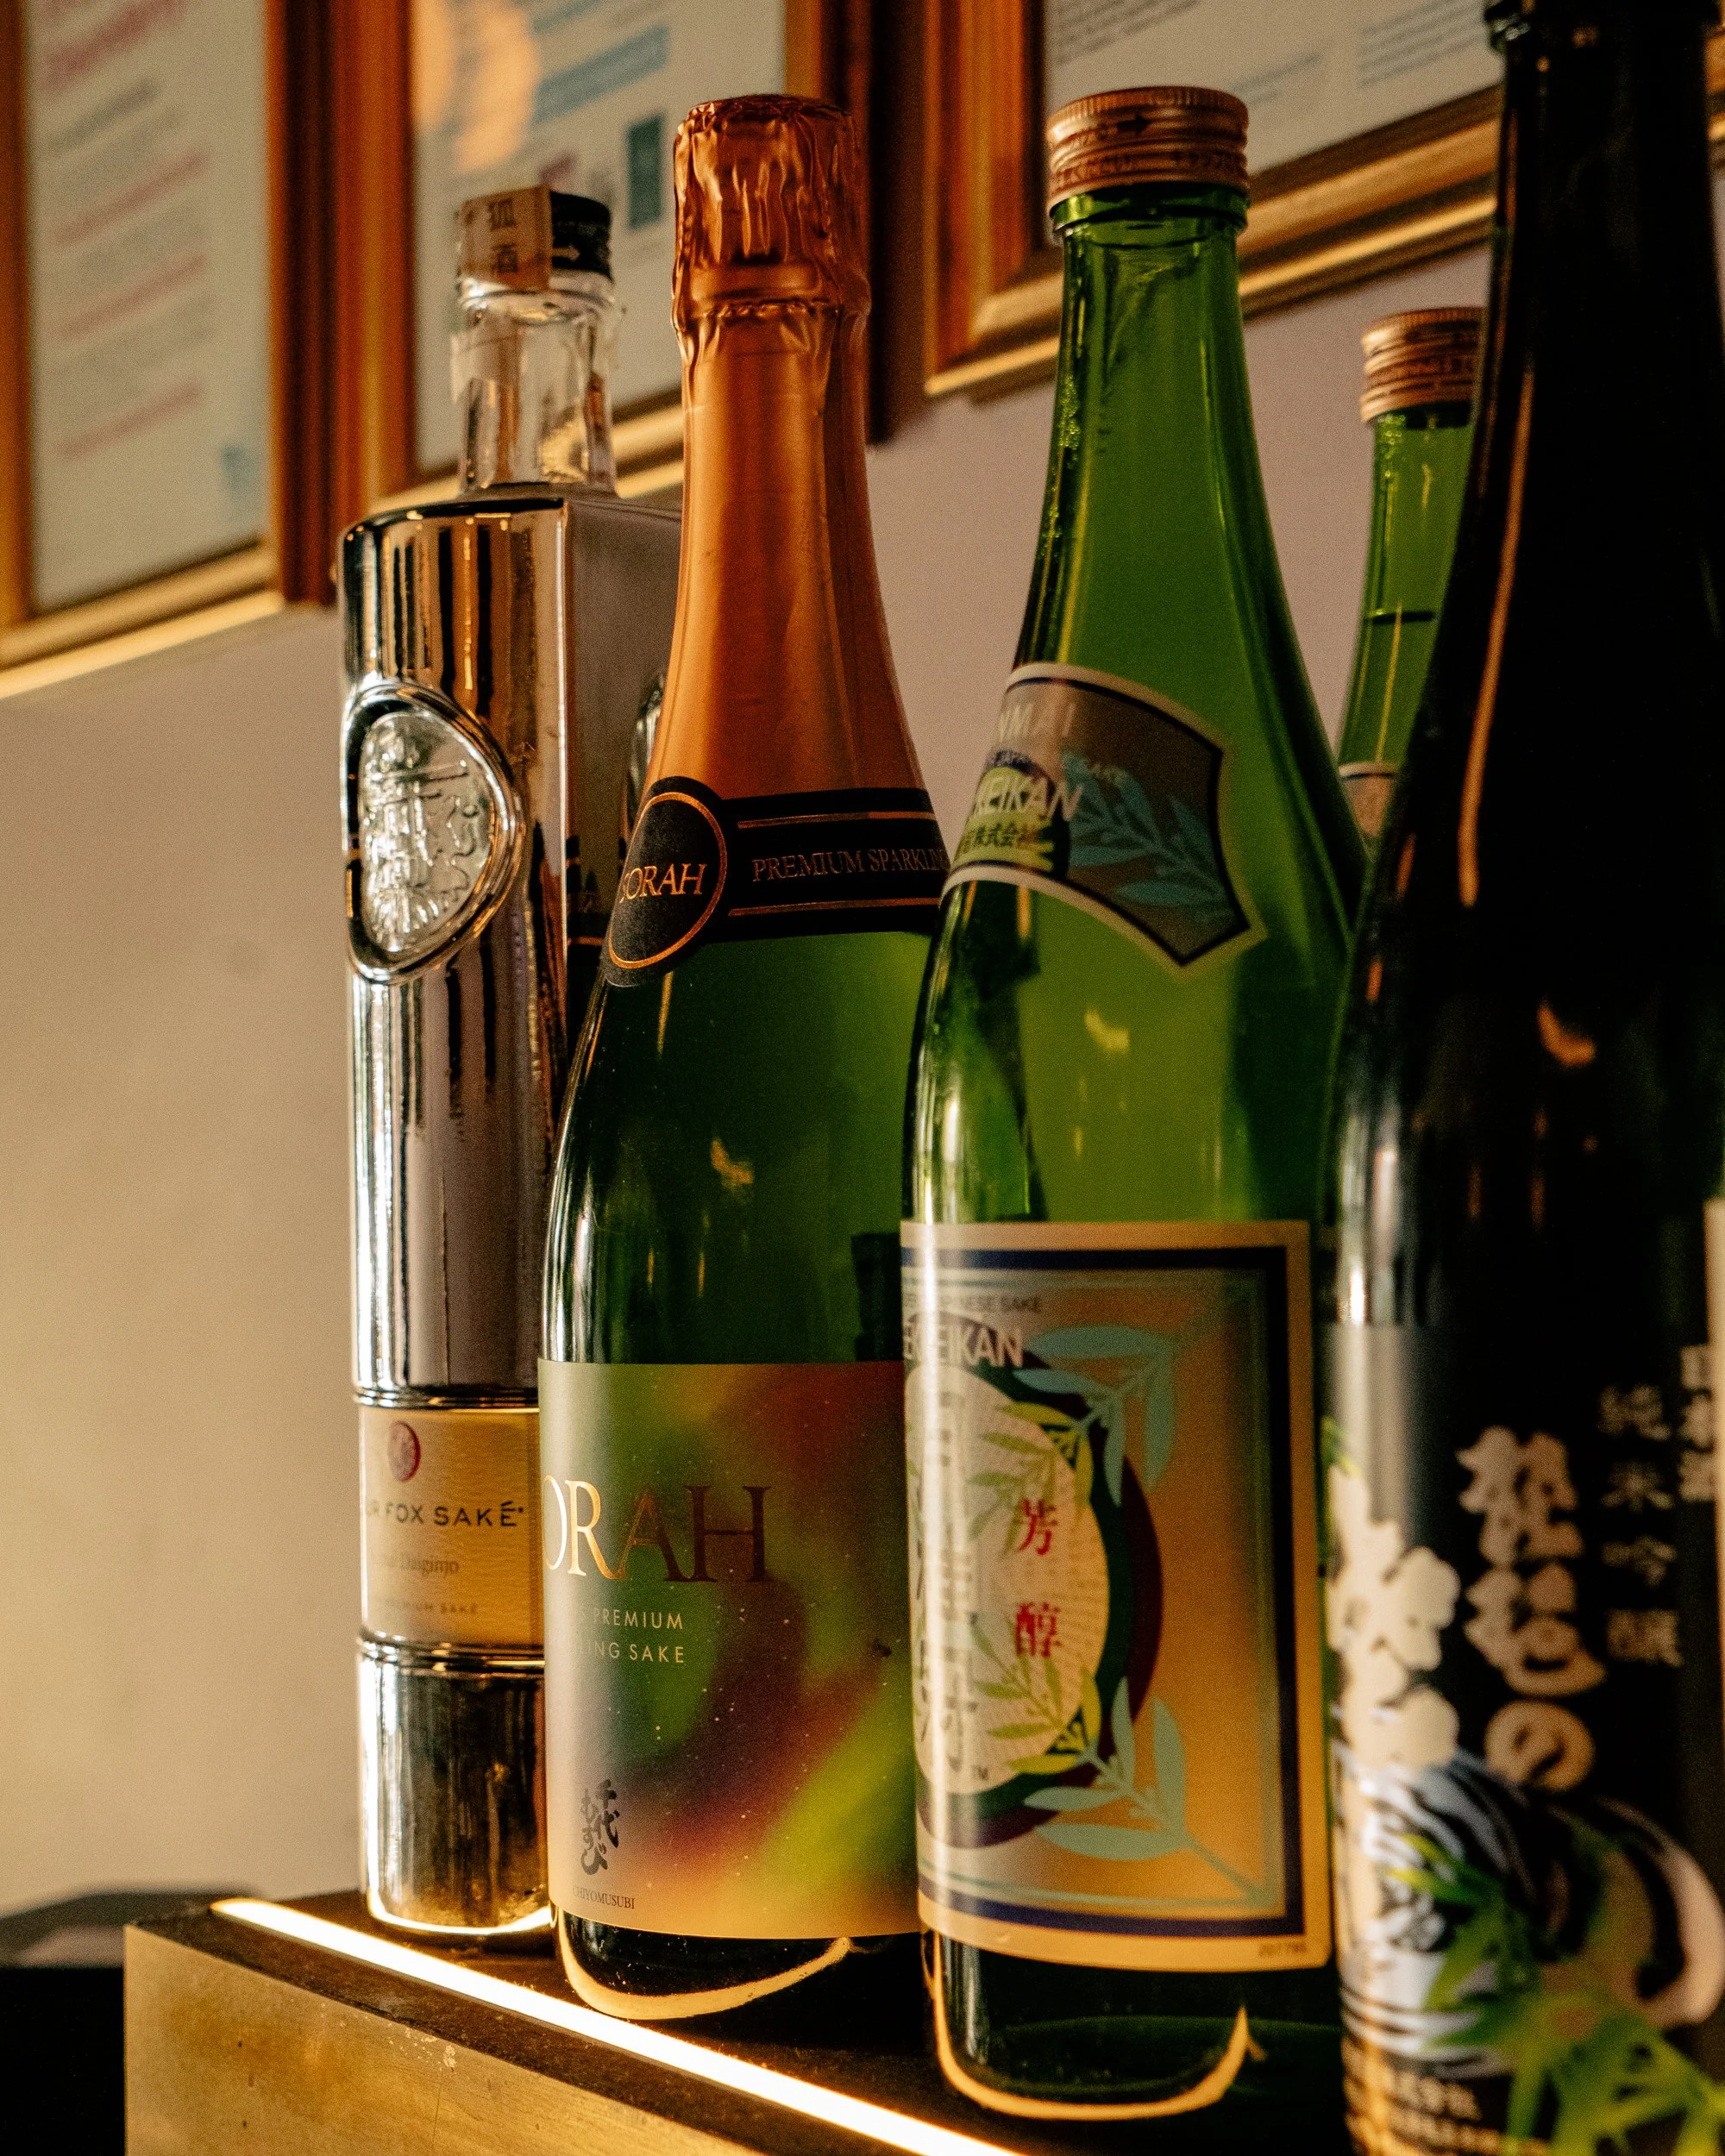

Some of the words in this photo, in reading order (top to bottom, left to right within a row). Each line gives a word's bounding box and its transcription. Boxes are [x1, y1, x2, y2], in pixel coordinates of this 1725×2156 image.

[752, 849, 864, 883] PREMIUM
[386, 1501, 424, 1525] FOX
[1014, 1497, 1063, 1658] 芳醇
[593, 1607, 684, 1631] PREMIUM
[629, 1643, 685, 1664] SAKE
[572, 1883, 636, 1910] CHIYOMUSUBI
